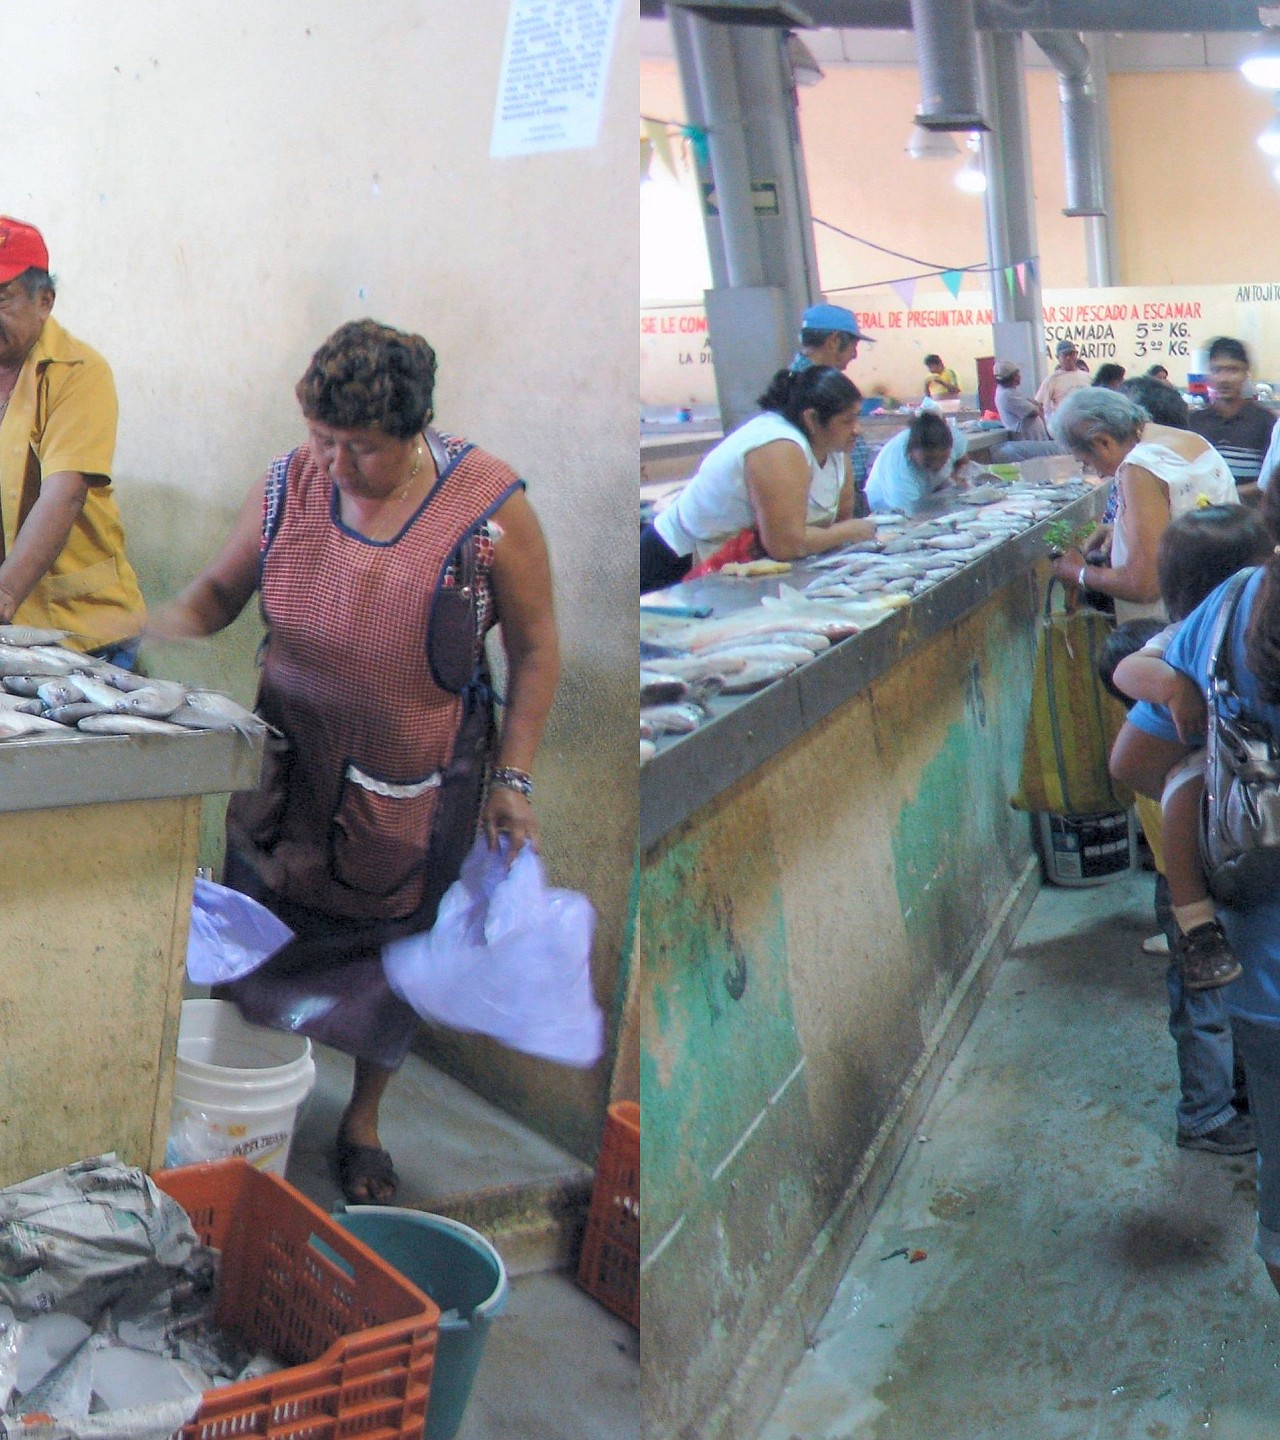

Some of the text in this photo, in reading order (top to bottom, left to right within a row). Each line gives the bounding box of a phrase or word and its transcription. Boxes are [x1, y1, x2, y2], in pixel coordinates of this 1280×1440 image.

[640, 316, 657, 334] SE
[660, 316, 676, 334] LE
[679, 316, 708, 334] COM
[855, 311, 884, 329] ERAL
[888, 311, 902, 329] DE
[907, 309, 973, 328] PREGUNTAR
[976, 308, 994, 326] AN
[1058, 305, 1073, 323] SU
[1076, 304, 1128, 323] PESCADO
[1130, 303, 1139, 320] A
[1143, 301, 1202, 320] ESCAMAR
[1044, 323, 1115, 342] SCAMADA
[678, 352, 693, 365] LA
[700, 352, 713, 364] DI
